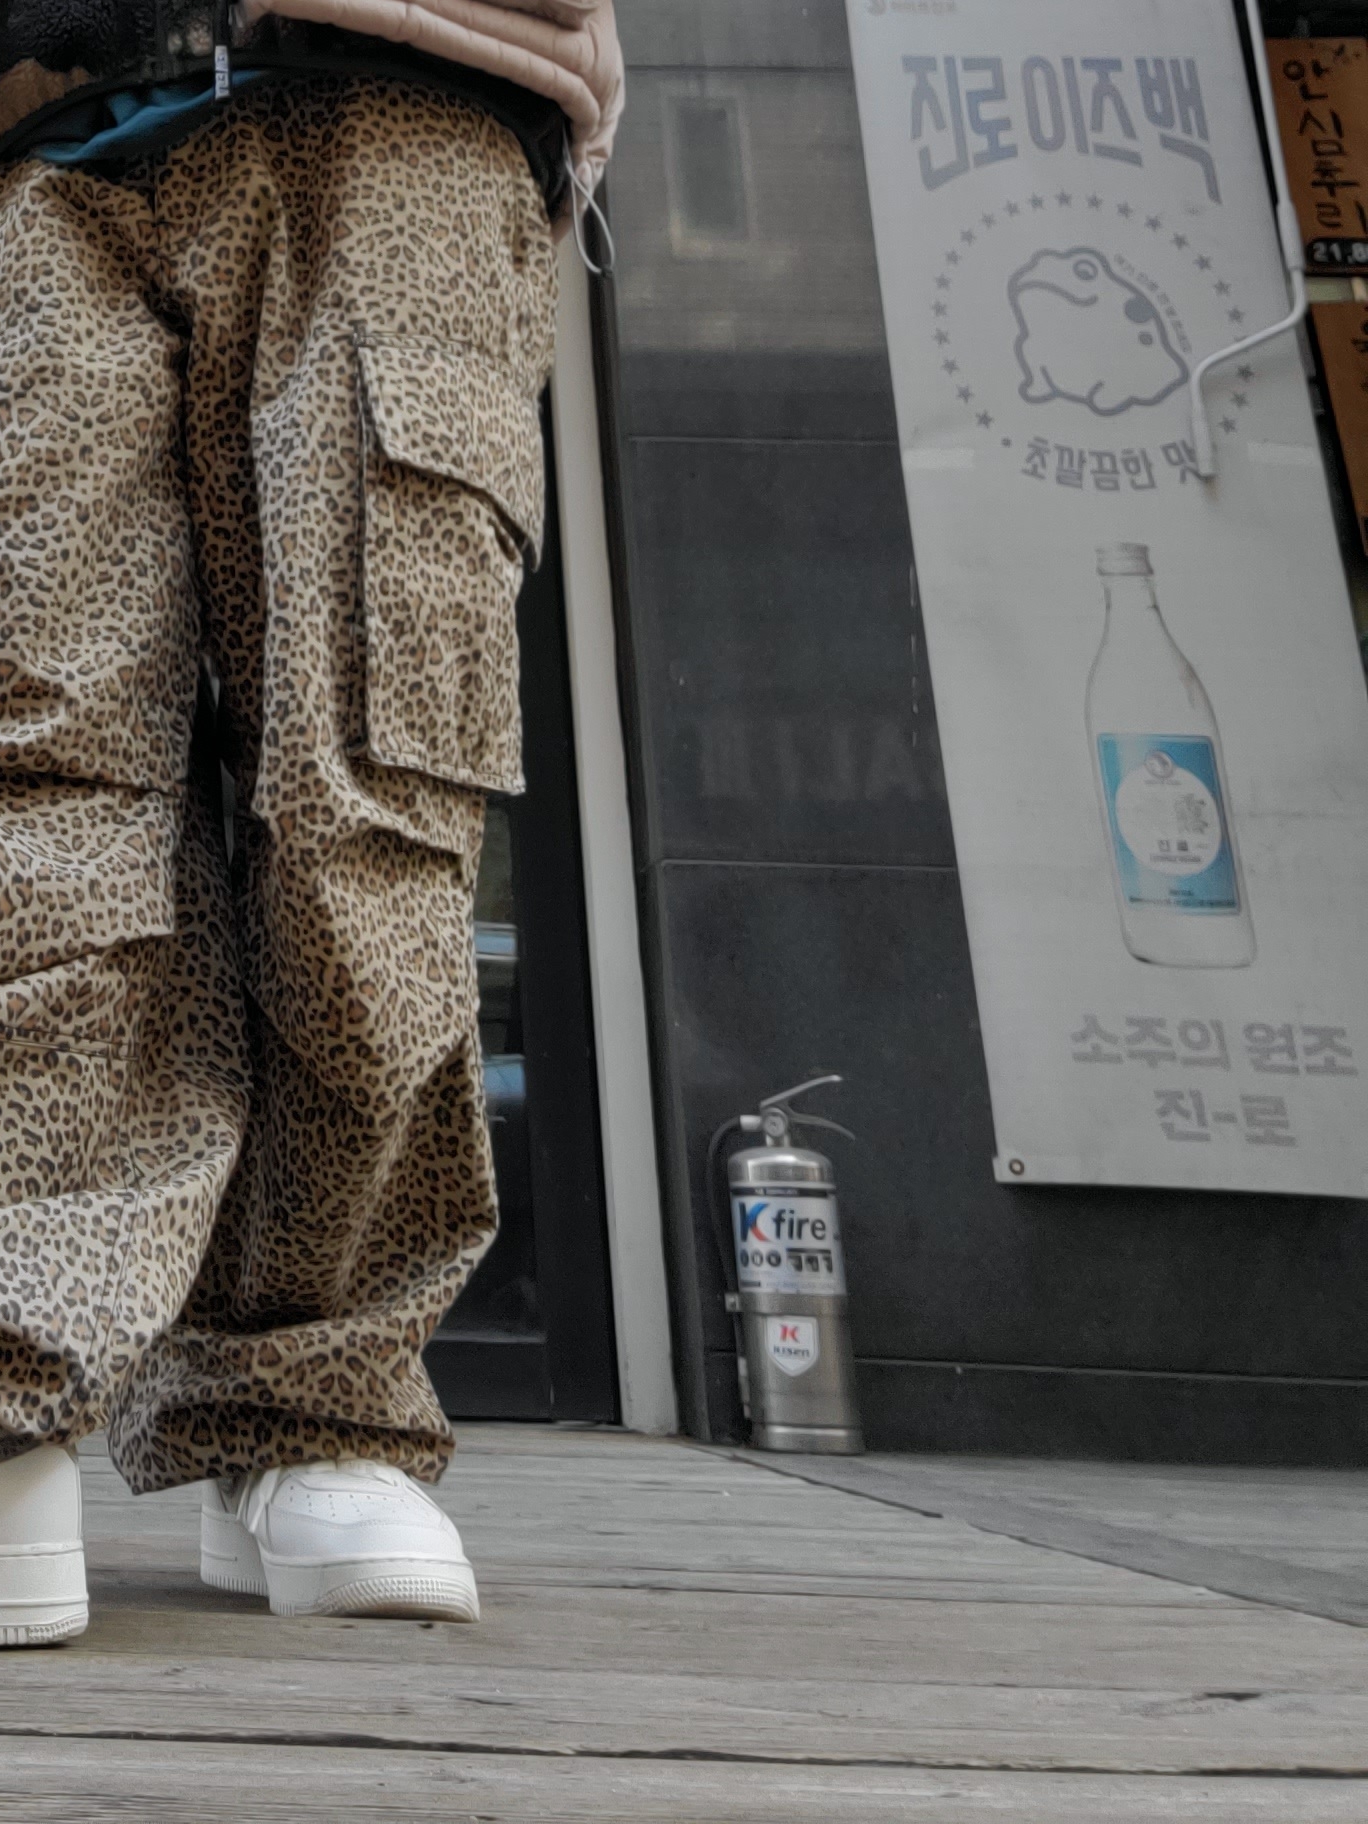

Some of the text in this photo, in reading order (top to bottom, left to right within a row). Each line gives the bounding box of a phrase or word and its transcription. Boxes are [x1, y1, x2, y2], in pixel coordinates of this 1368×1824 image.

[901, 54, 1222, 206] 진로이즈백
[1070, 1014, 1359, 1077] 소주의 원조
